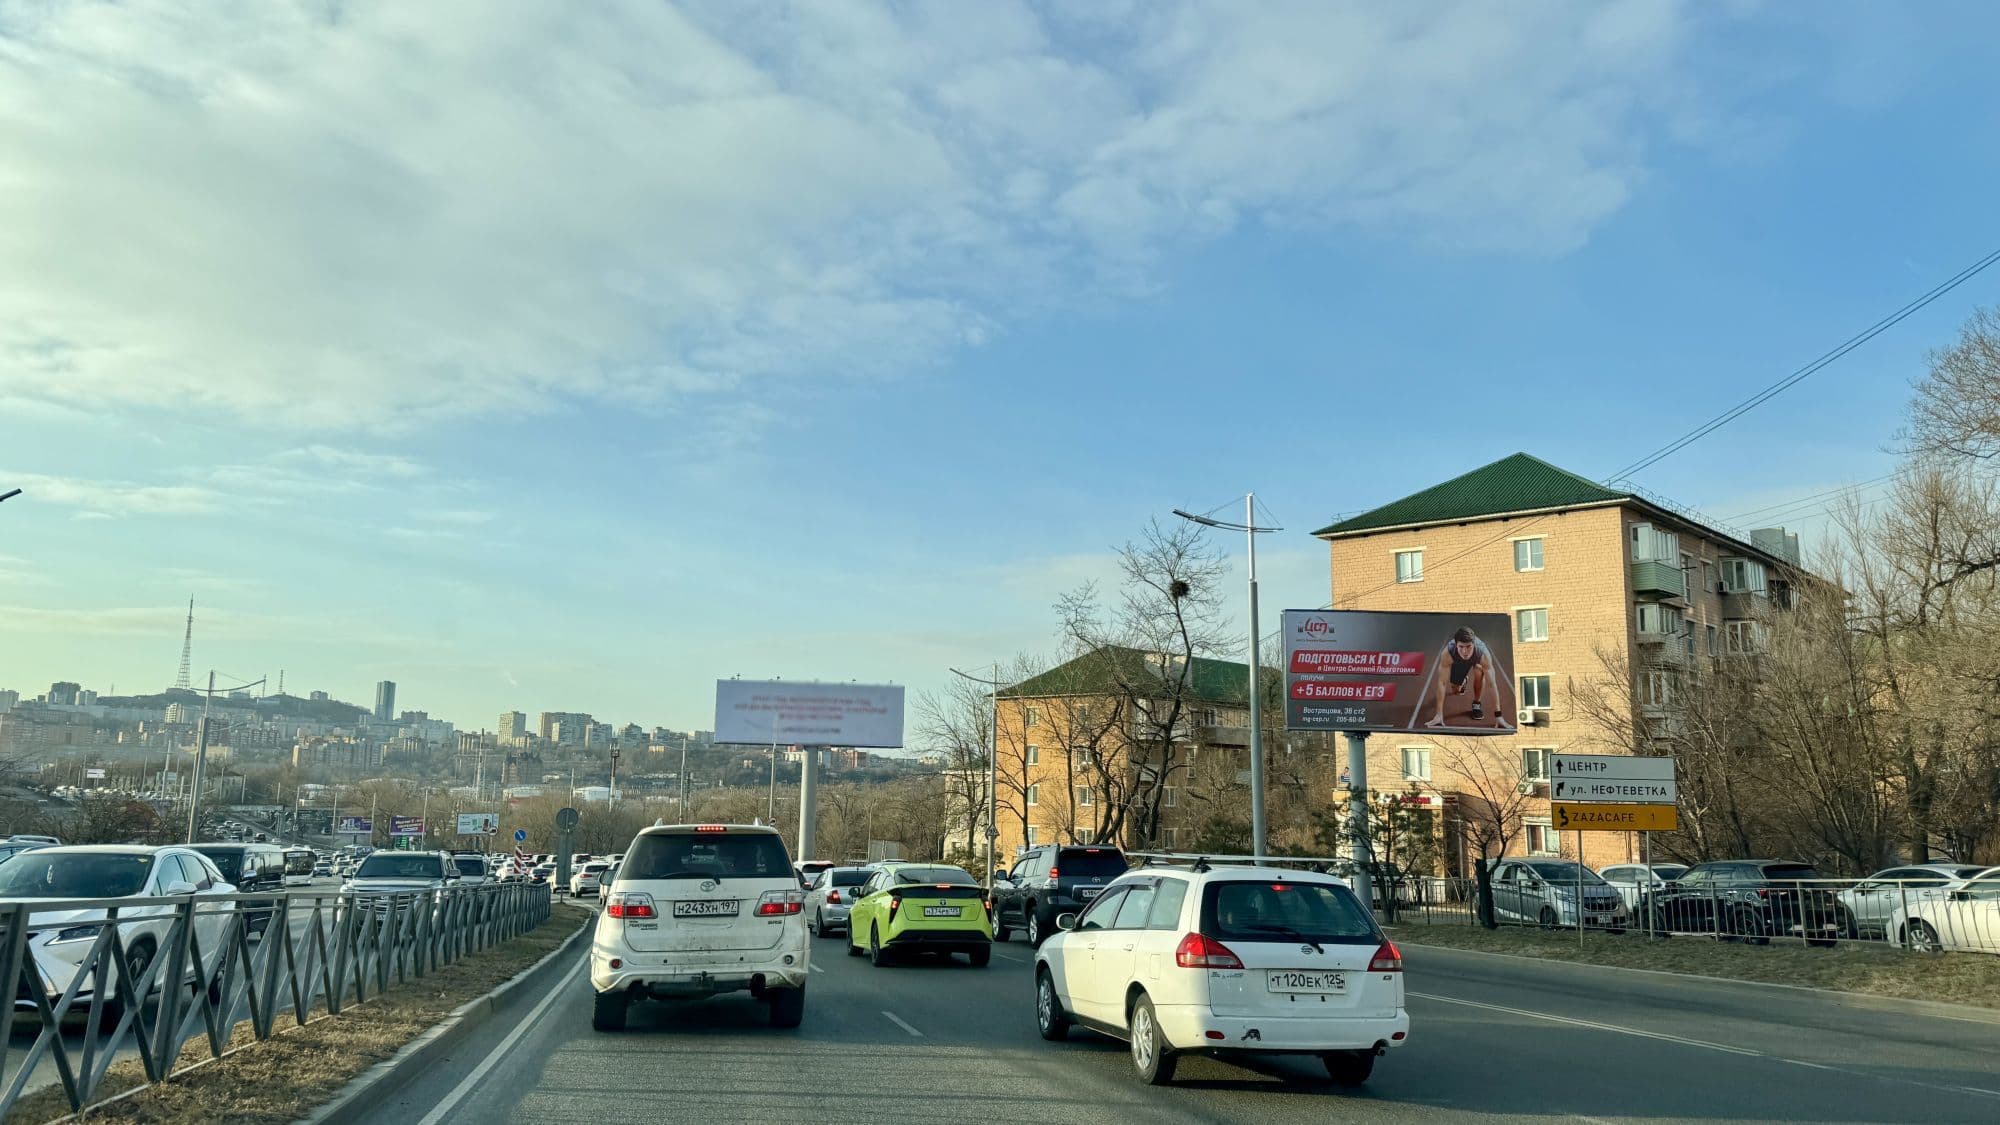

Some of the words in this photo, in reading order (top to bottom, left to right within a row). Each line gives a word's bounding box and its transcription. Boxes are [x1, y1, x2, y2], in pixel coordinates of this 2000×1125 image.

[1297, 653, 1367, 665] ПОДГОТОВЬСЯ
[1368, 654, 1376, 665] К
[1377, 653, 1400, 665] ГТО
[1315, 687, 1354, 697] БАЛЛОВ
[1355, 687, 1362, 697] К
[1365, 686, 1385, 698] ЕГЭ
[1568, 761, 1607, 773] ЦЕНТР
[1570, 786, 1587, 796] ул.
[1591, 784, 1667, 796] НЕФТЕВЕТКА
[1572, 812, 1635, 823] ZAZACAFE
